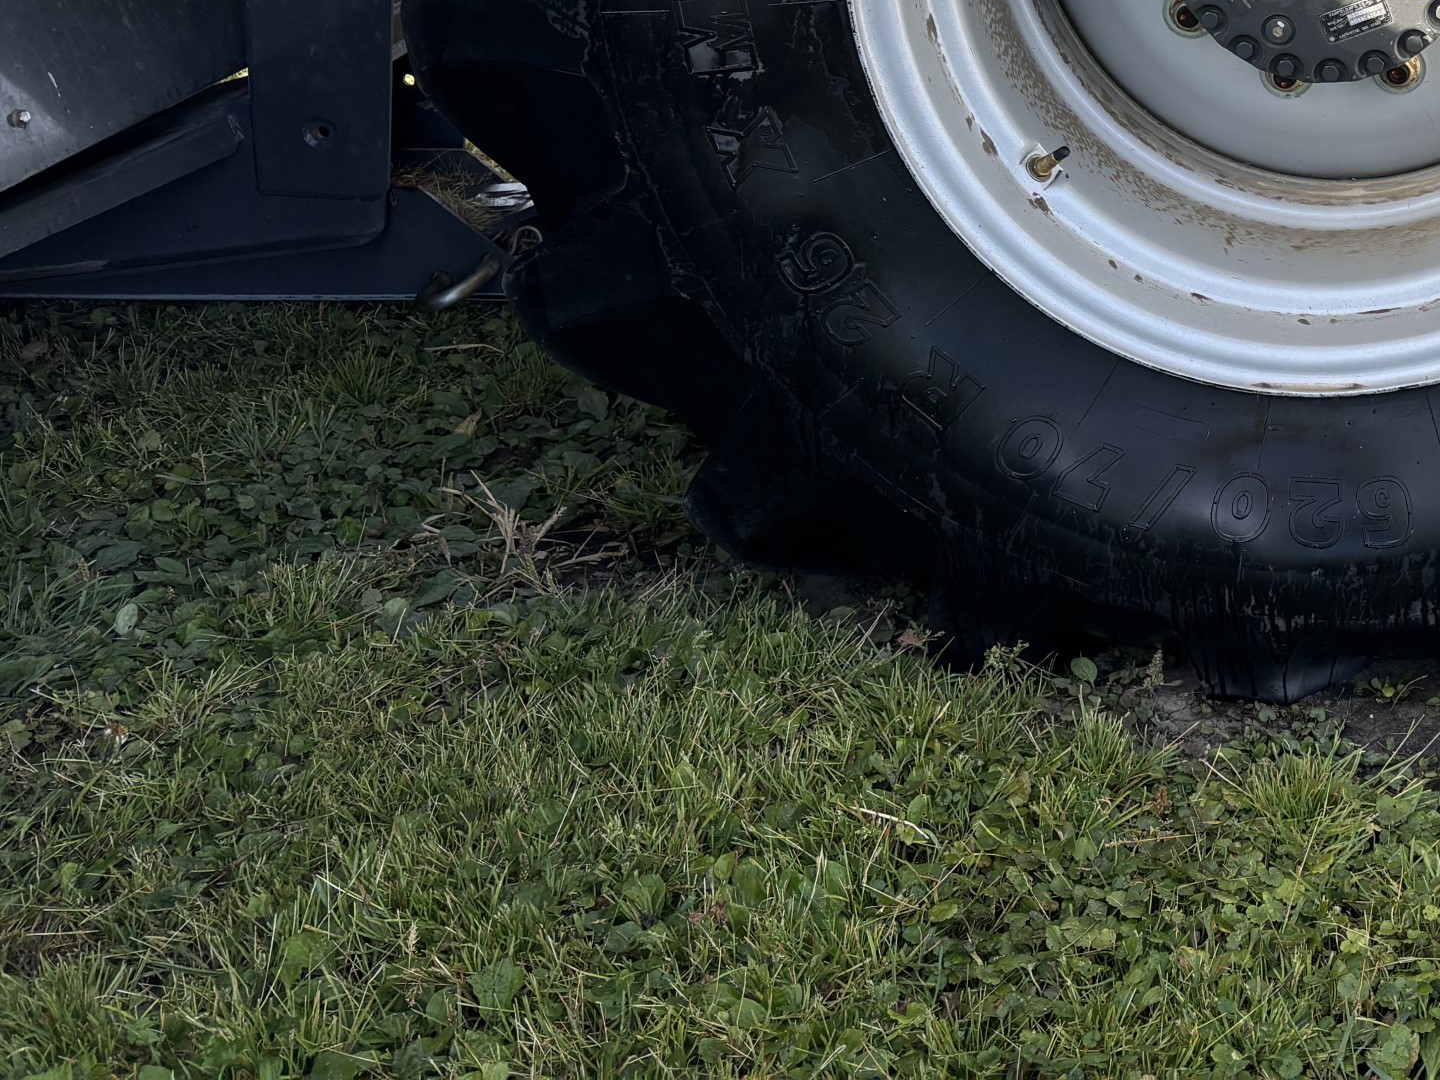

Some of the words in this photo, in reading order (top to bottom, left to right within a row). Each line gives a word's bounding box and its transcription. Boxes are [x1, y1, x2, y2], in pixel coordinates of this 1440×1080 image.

[777, 230, 901, 347] 26
[901, 345, 987, 431] R
[995, 414, 1414, 550] 620/70
